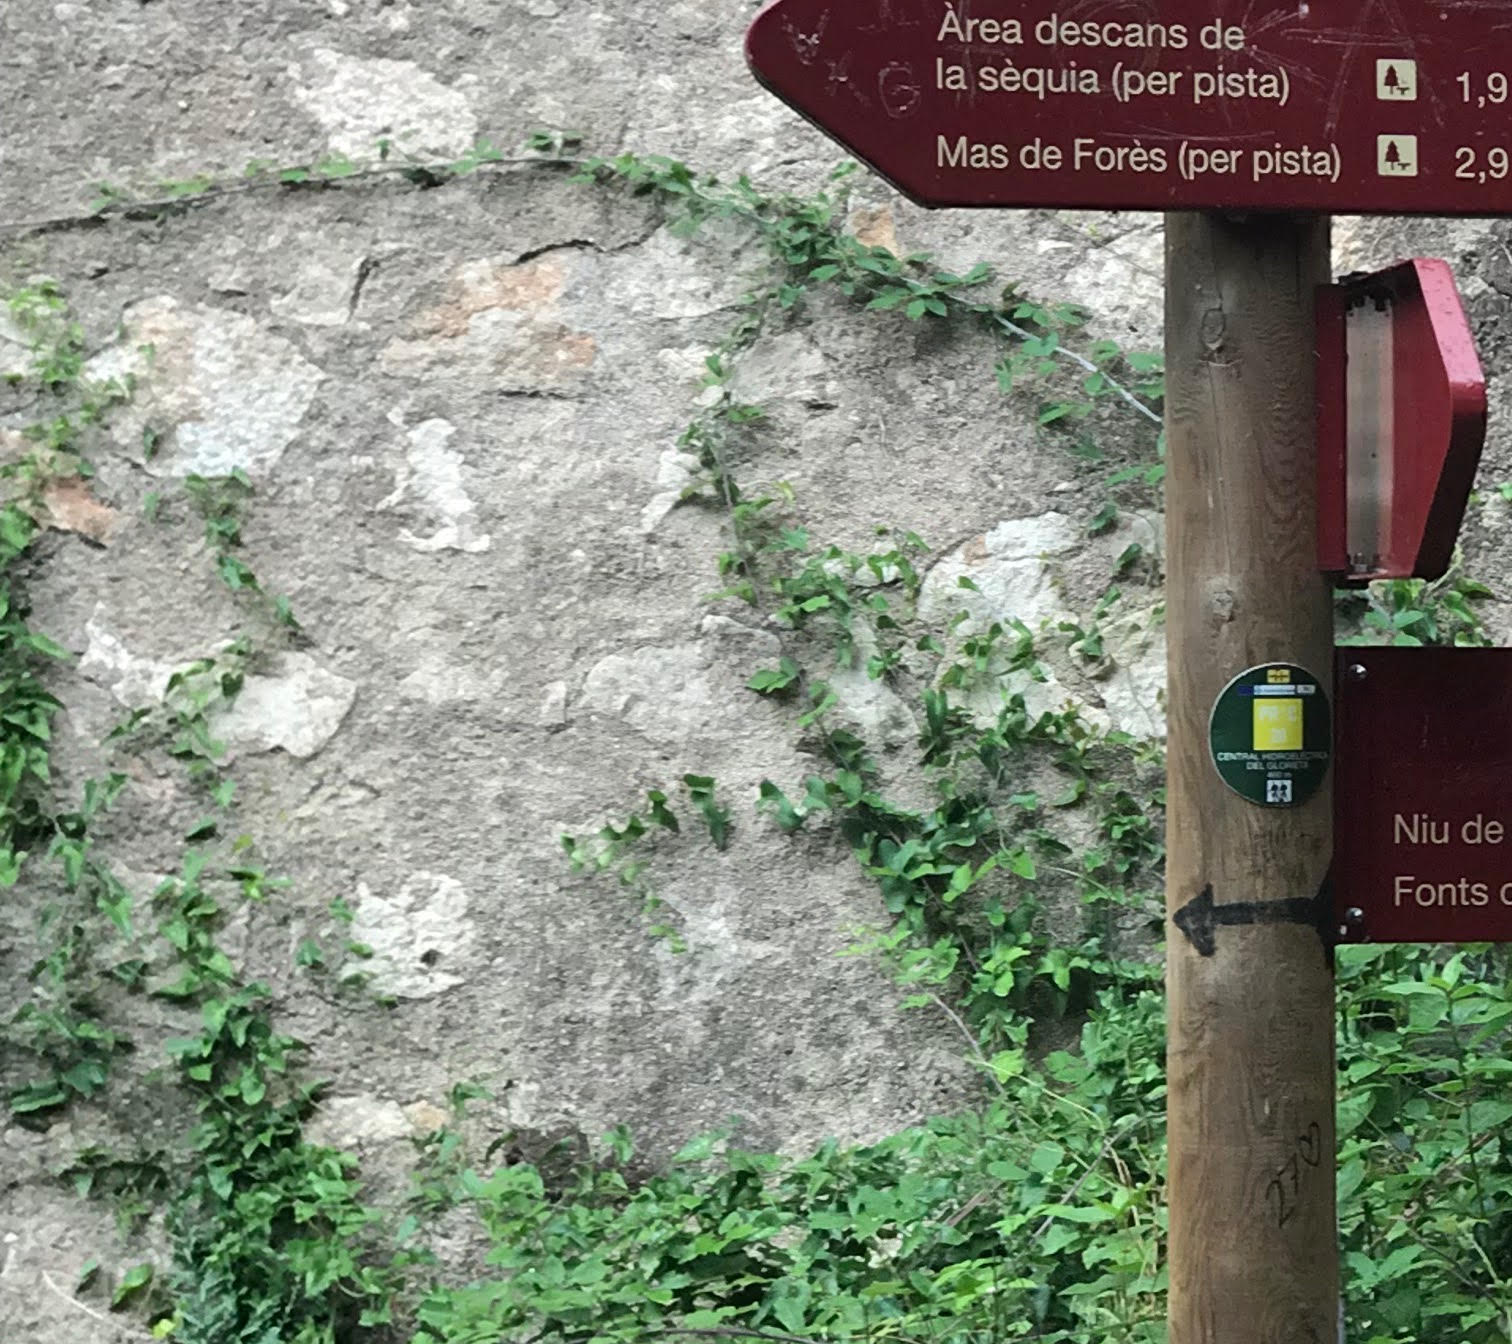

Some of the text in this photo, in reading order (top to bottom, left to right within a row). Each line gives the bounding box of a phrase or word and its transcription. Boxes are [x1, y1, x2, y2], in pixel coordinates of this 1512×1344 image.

[937, 2, 1246, 51] Àrea descans de
[935, 58, 1291, 106] la sèquia (per pista)
[1455, 72, 1510, 109] 1,9
[936, 136, 1342, 183] Mas de Forès (per pista)
[1455, 147, 1510, 185] 2,9
[1394, 813, 1450, 844] Niu
[1461, 813, 1504, 844] de
[1394, 875, 1489, 906] Fonts
